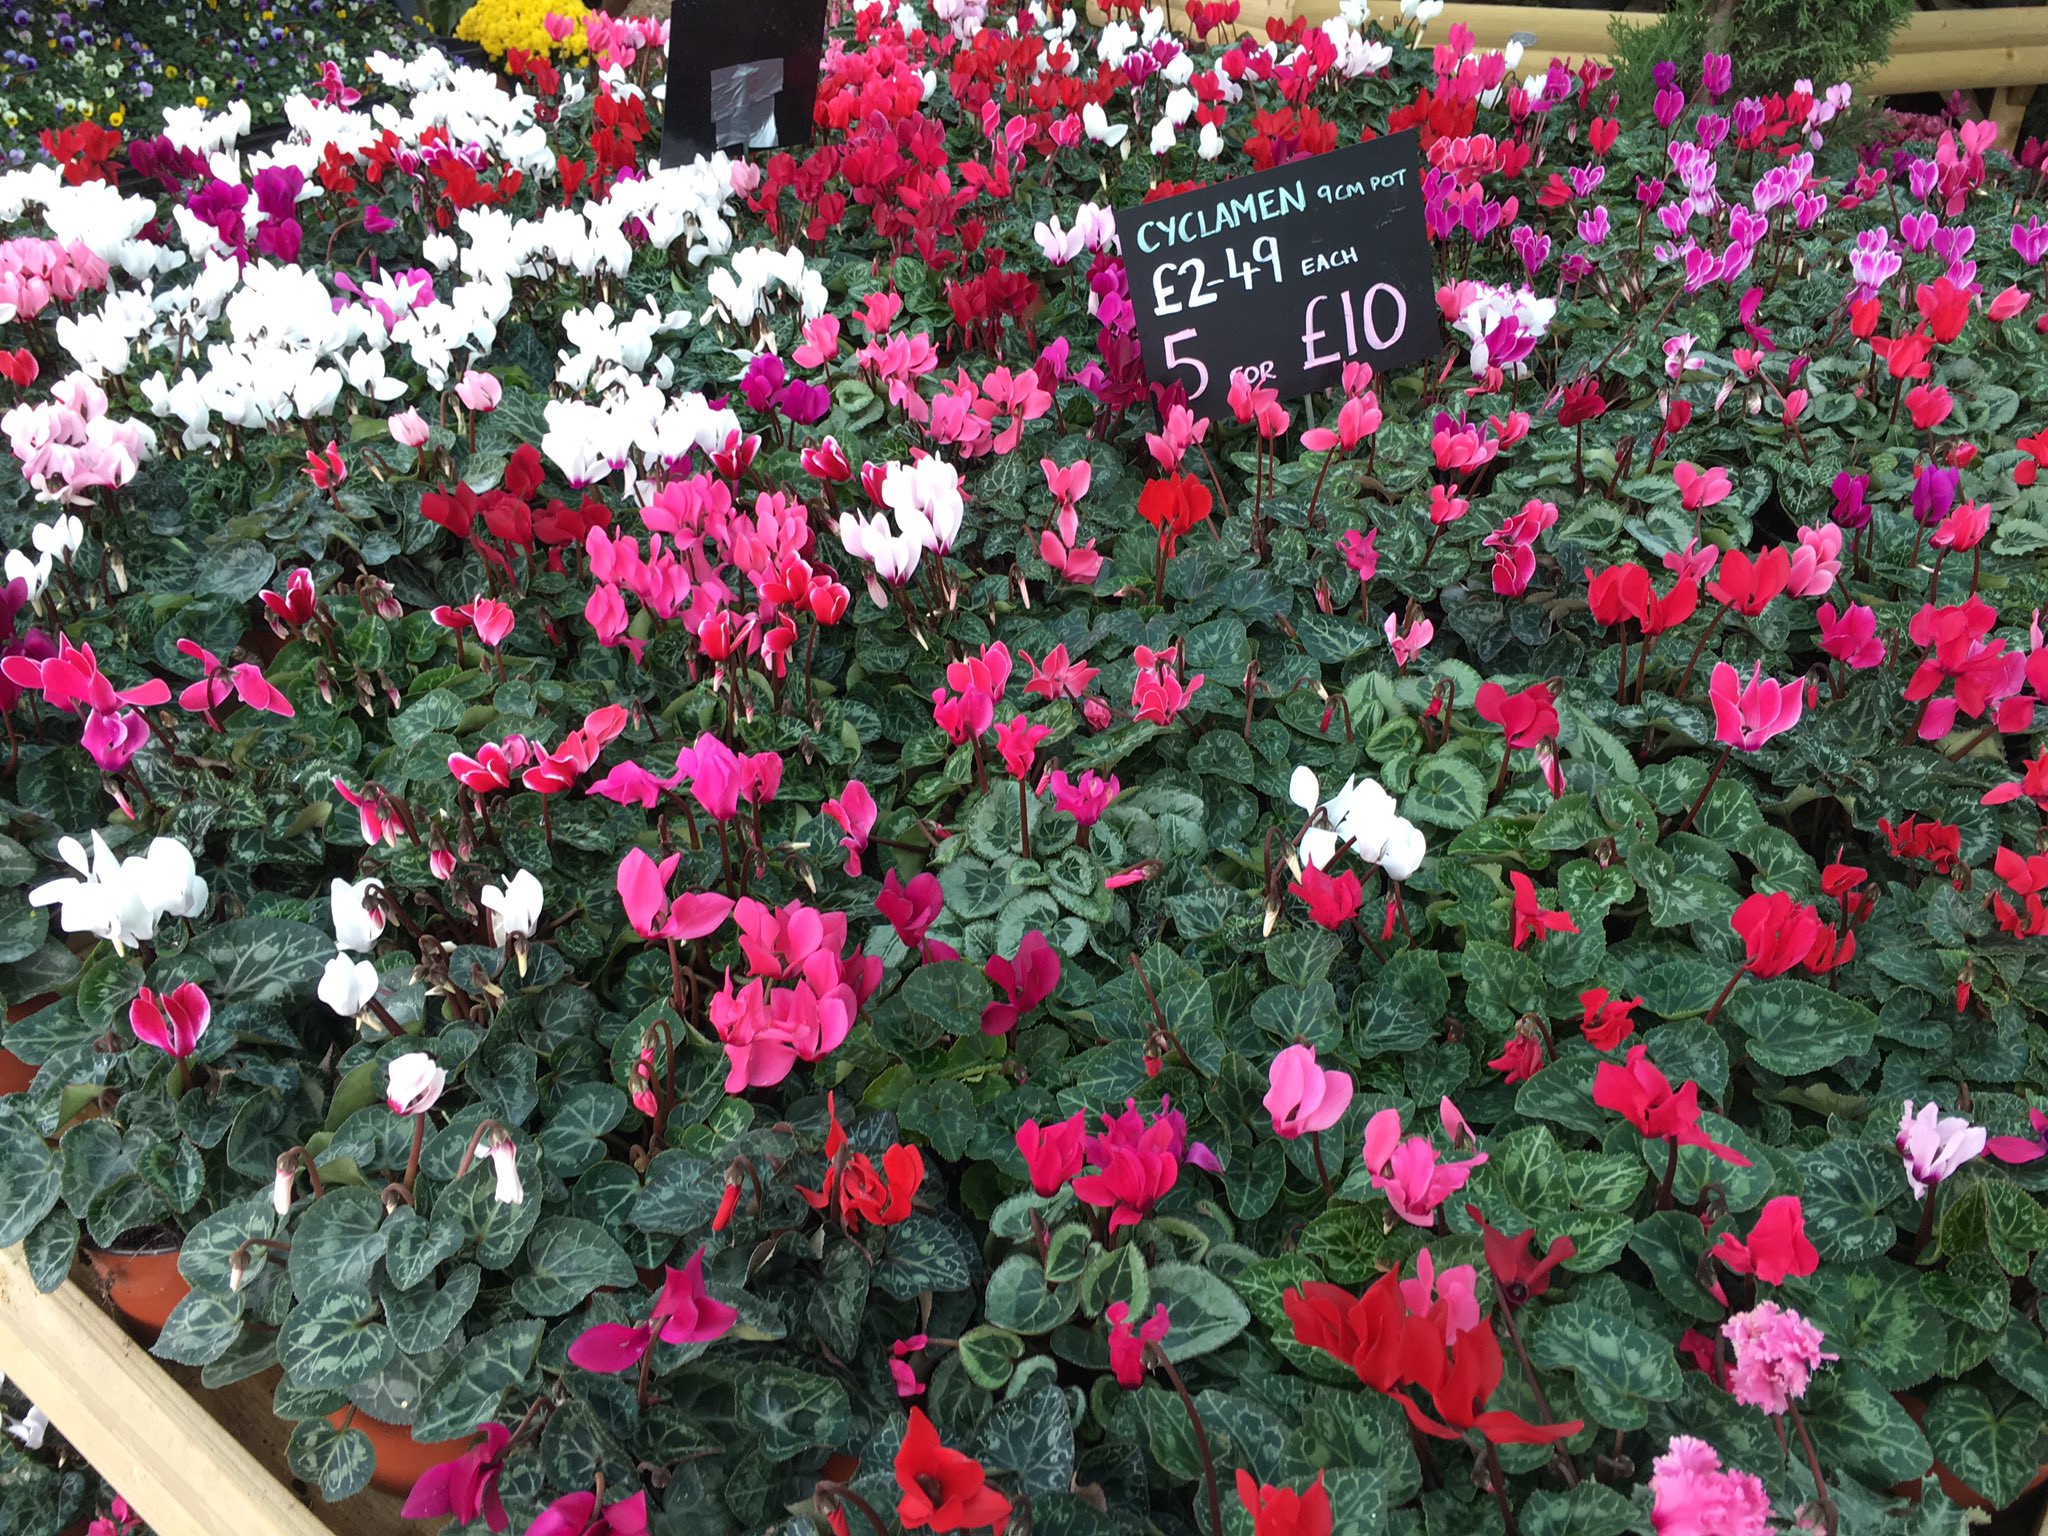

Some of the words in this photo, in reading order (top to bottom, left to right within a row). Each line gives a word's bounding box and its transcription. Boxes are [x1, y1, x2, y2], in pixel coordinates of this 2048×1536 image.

[1137, 180, 1306, 253] CYCLAMEN
[1317, 181, 1365, 204] 9CM
[1370, 168, 1407, 191] POT
[1301, 246, 1358, 277] EACH
[1163, 328, 1209, 401] 5
[1301, 282, 1407, 370] £10
